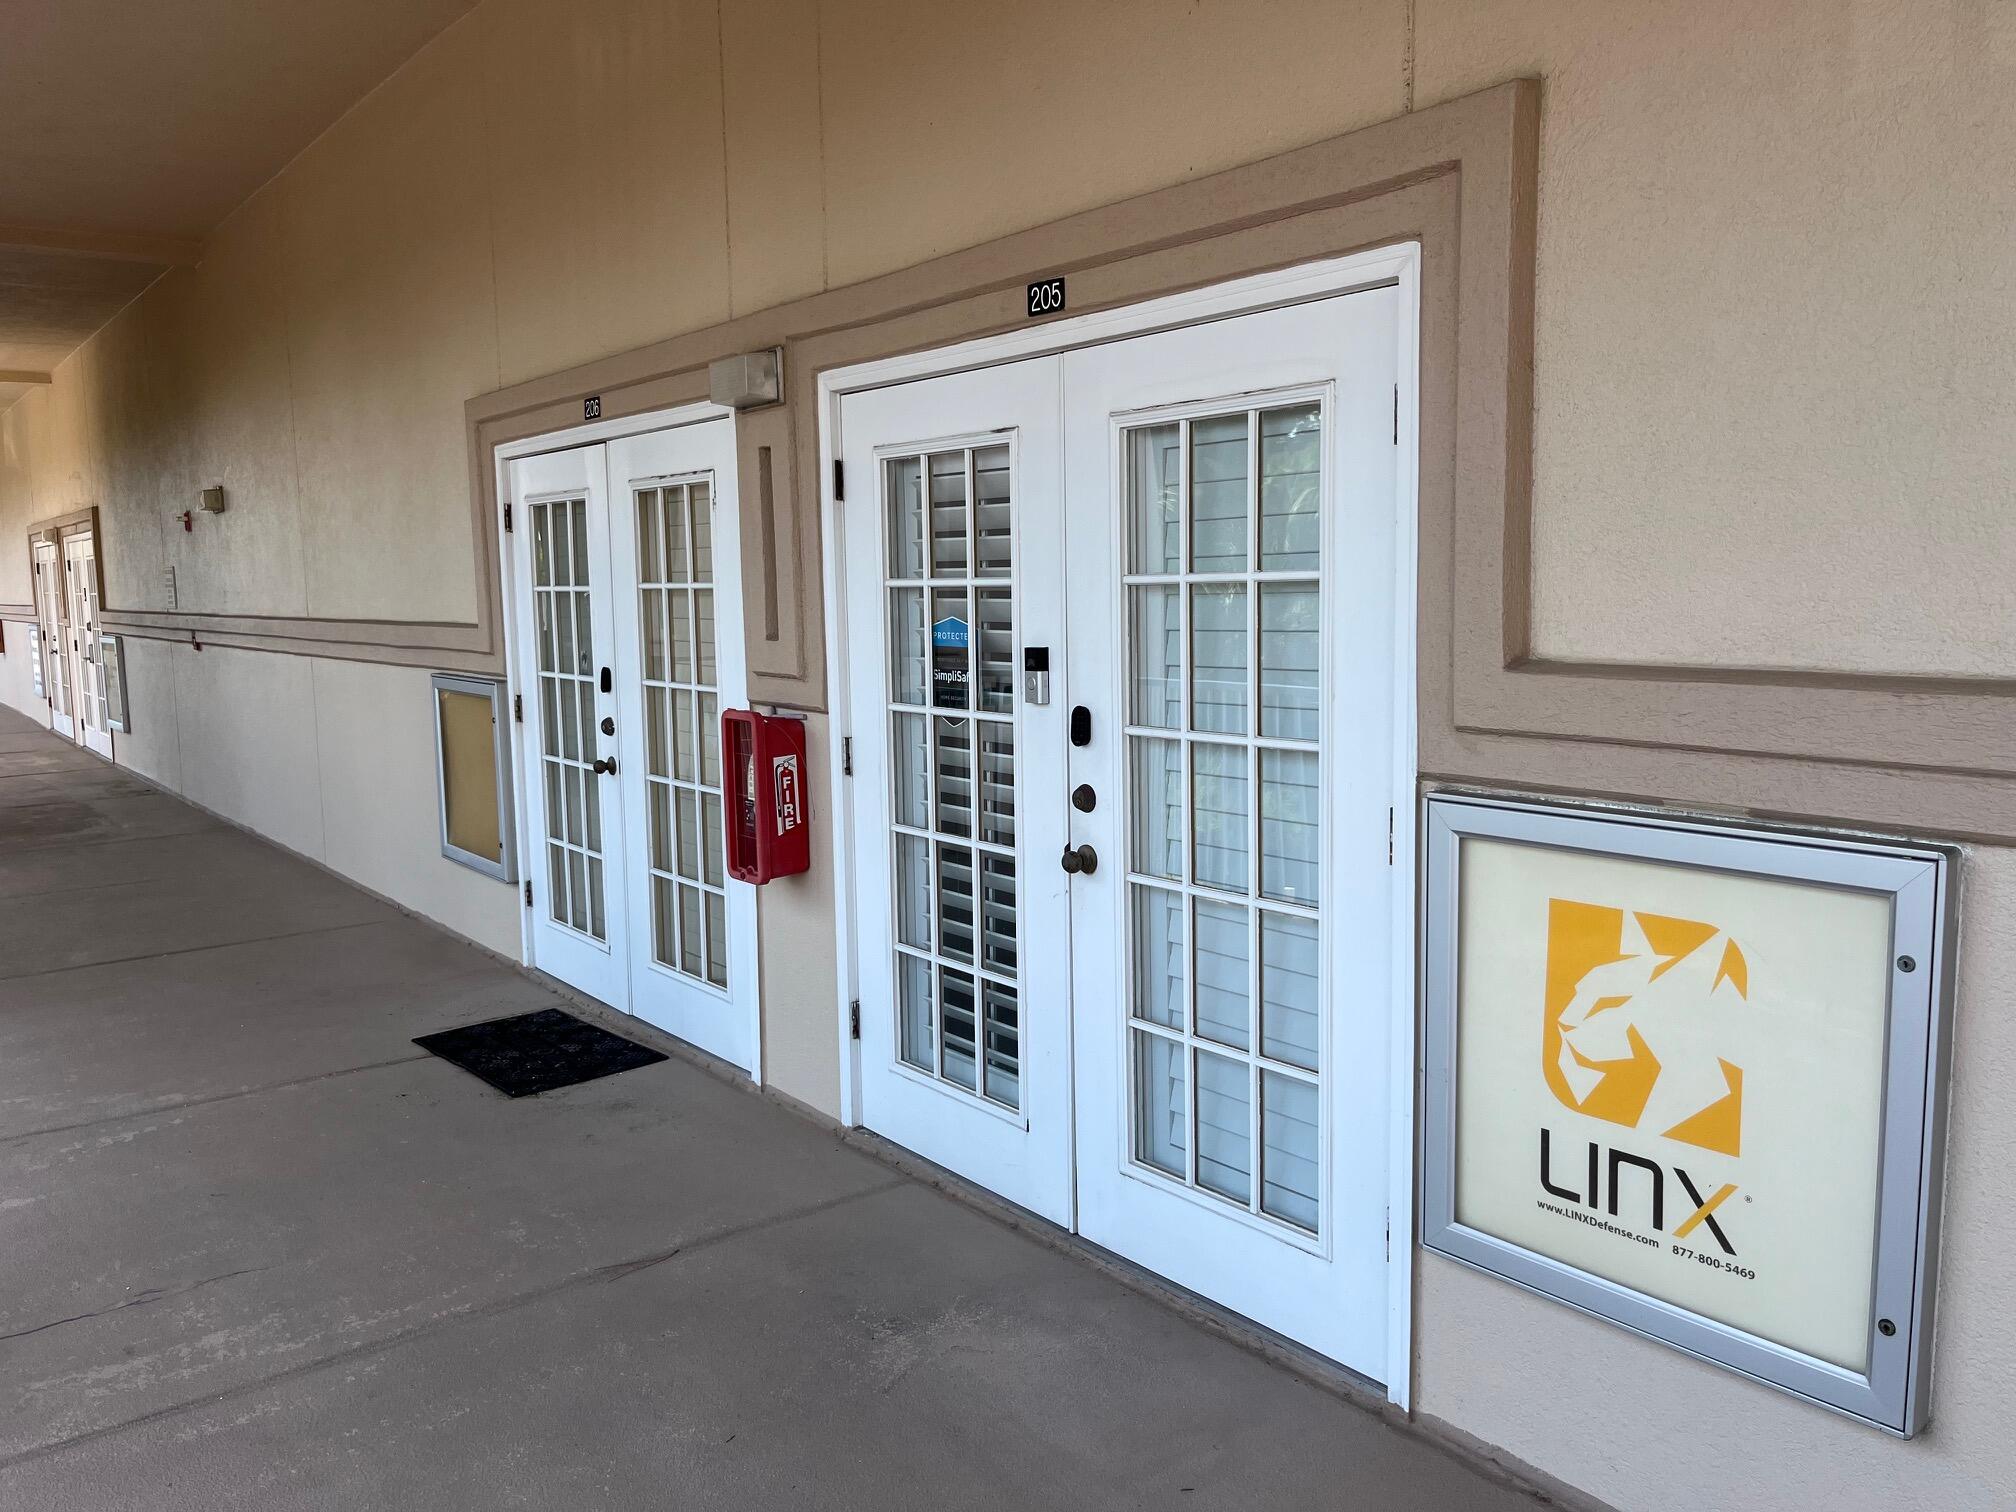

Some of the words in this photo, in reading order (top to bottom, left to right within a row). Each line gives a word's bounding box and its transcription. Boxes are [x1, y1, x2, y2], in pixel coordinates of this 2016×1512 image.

[1030, 282, 1062, 312] 205
[585, 399, 600, 418] 206
[933, 631, 968, 641] PROTECTE
[933, 669, 970, 684] SimpliSaf
[782, 776, 796, 830] FIRE
[1536, 1200, 1660, 1249] www.LINXDefense.com
[1671, 1244, 1756, 1280] 877-800-5469
